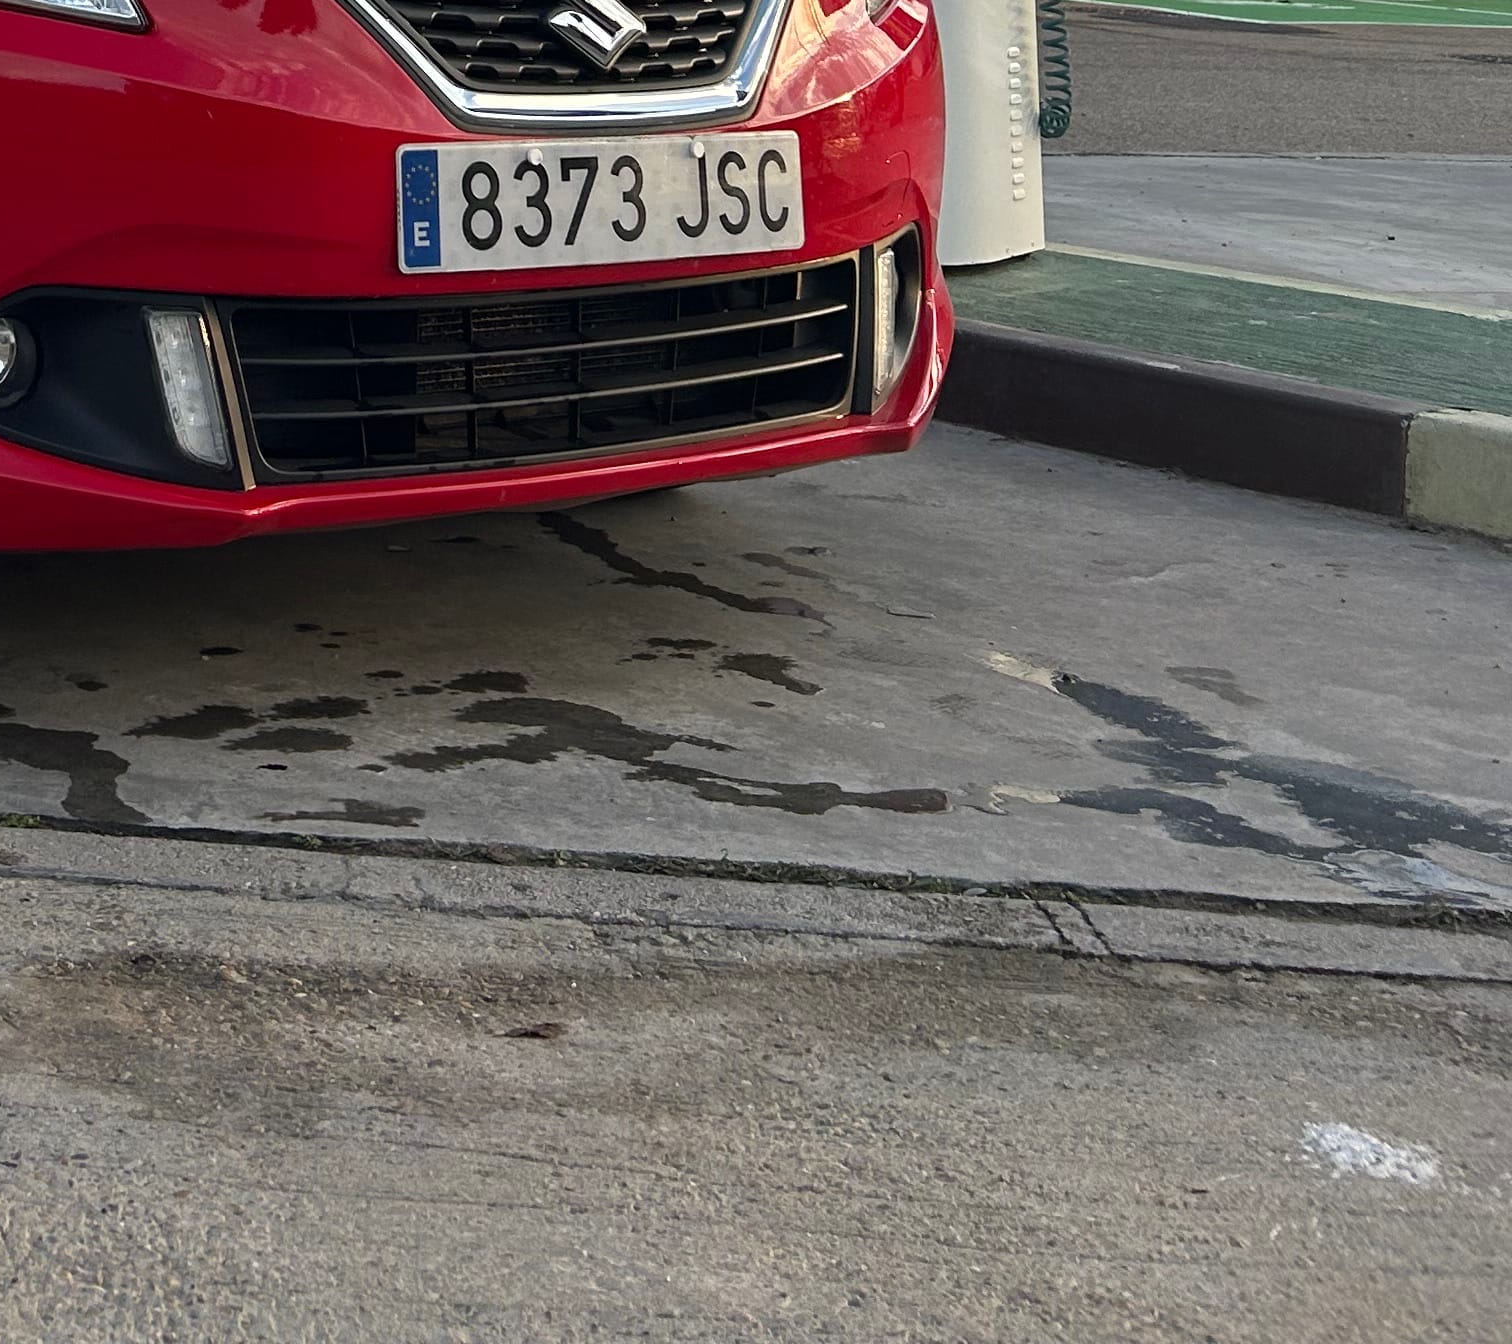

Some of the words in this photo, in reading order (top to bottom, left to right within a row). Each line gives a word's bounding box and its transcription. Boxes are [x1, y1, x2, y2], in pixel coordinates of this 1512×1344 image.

[413, 221, 430, 247] E
[461, 154, 646, 251] 8373
[676, 148, 789, 238] JSC
